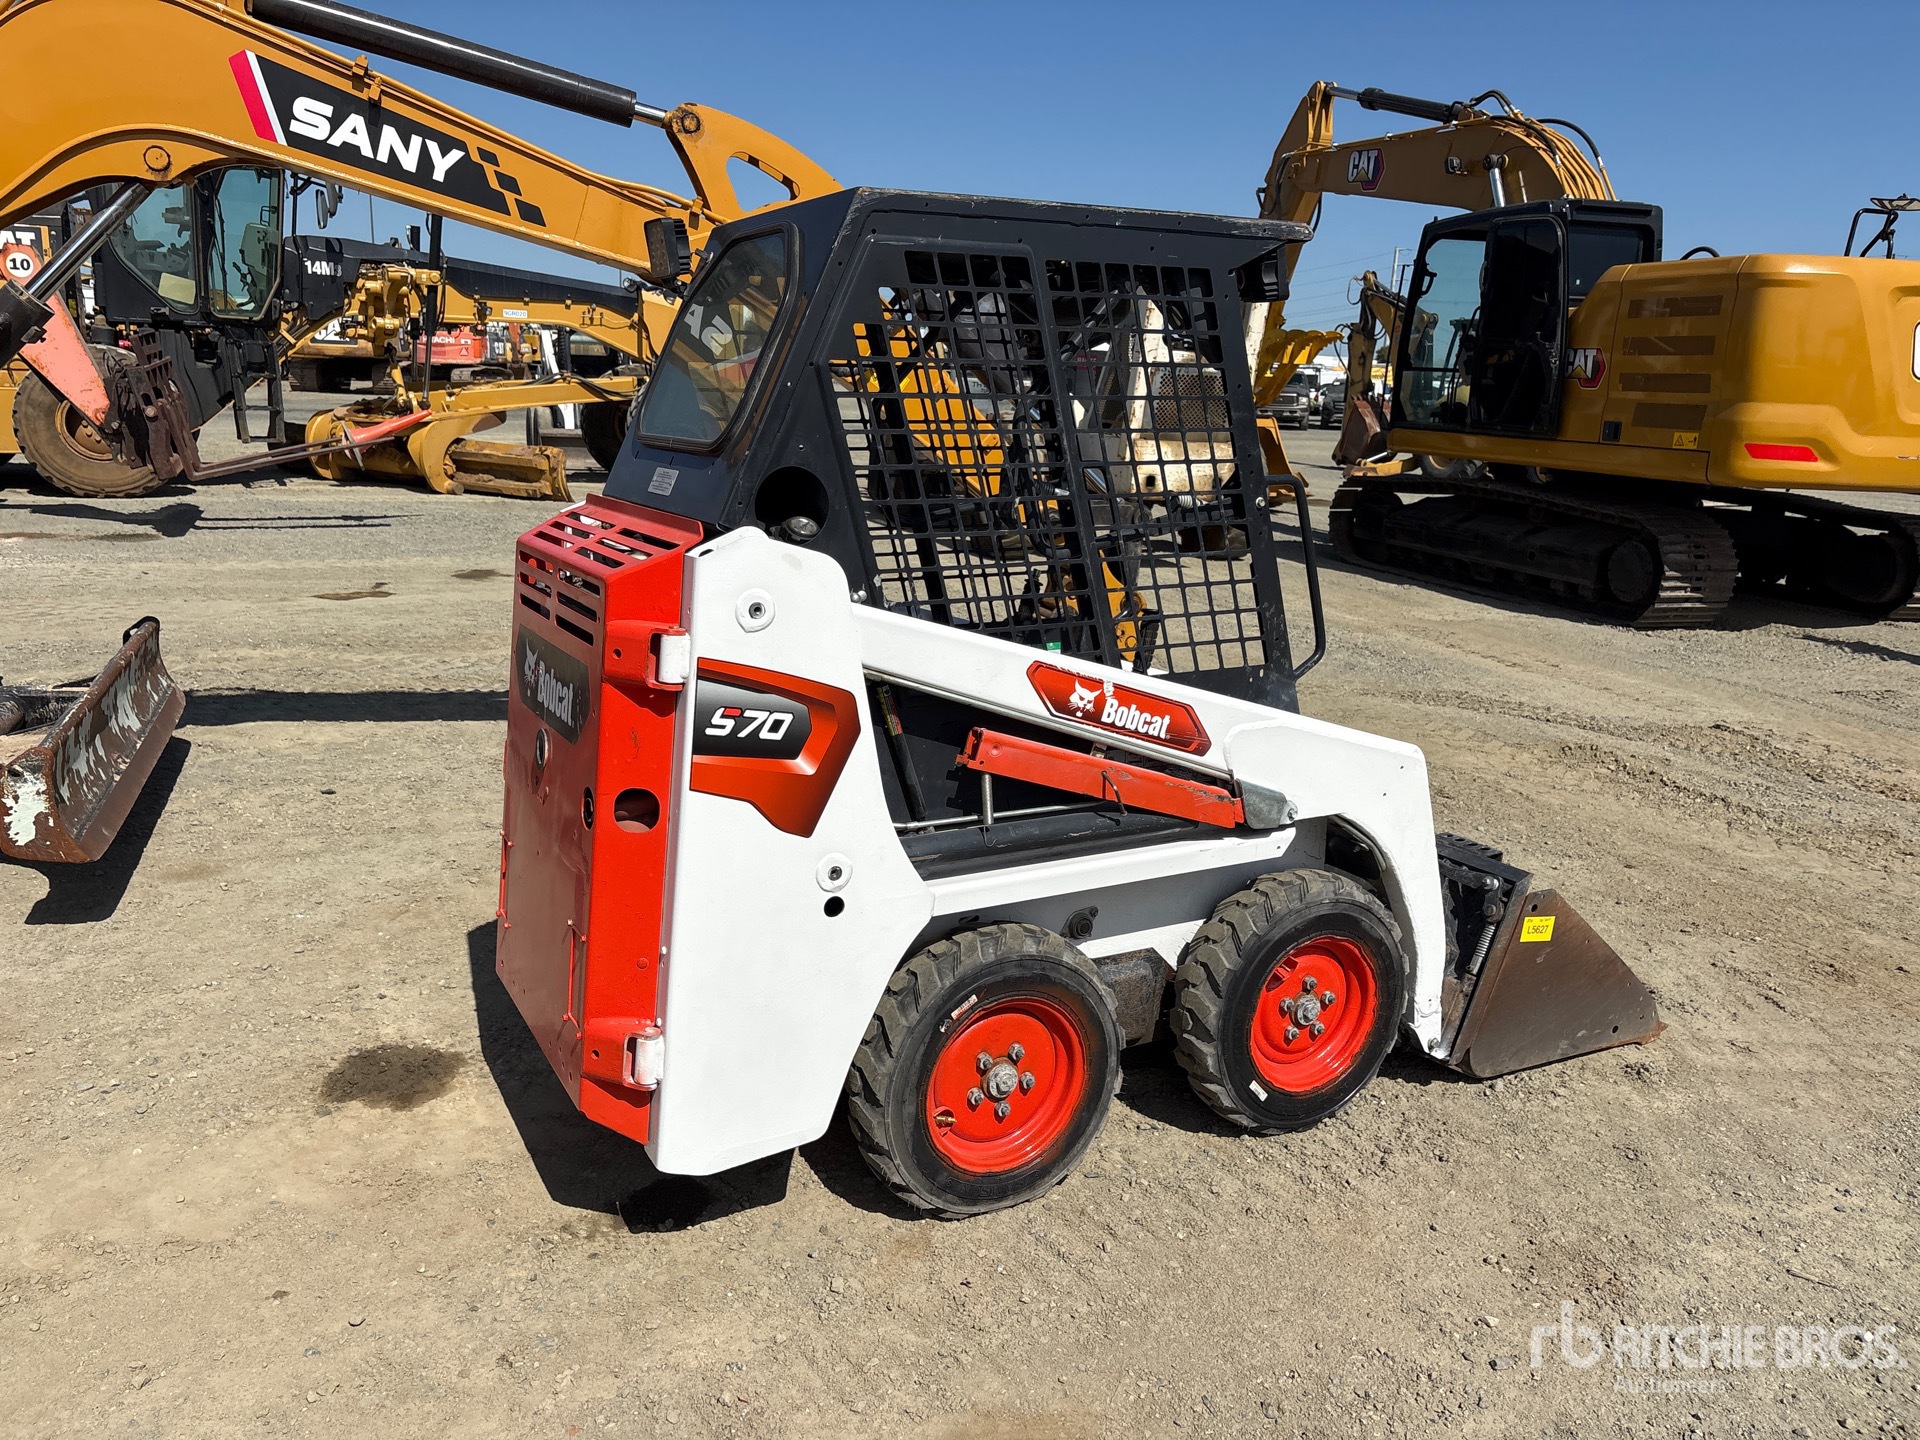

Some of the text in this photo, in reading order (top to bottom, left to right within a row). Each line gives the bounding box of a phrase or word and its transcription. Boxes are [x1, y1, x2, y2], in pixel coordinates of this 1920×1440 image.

[289, 96, 466, 183] SANY
[1348, 150, 1379, 182] CAT
[9, 257, 31, 271] 10
[422, 335, 455, 344] HTACHI
[1566, 348, 1598, 379] CAT
[537, 660, 574, 728] Bobcat
[704, 707, 795, 741] S70
[1101, 698, 1170, 740] Bobcat
[1527, 925, 1549, 934] L5627
